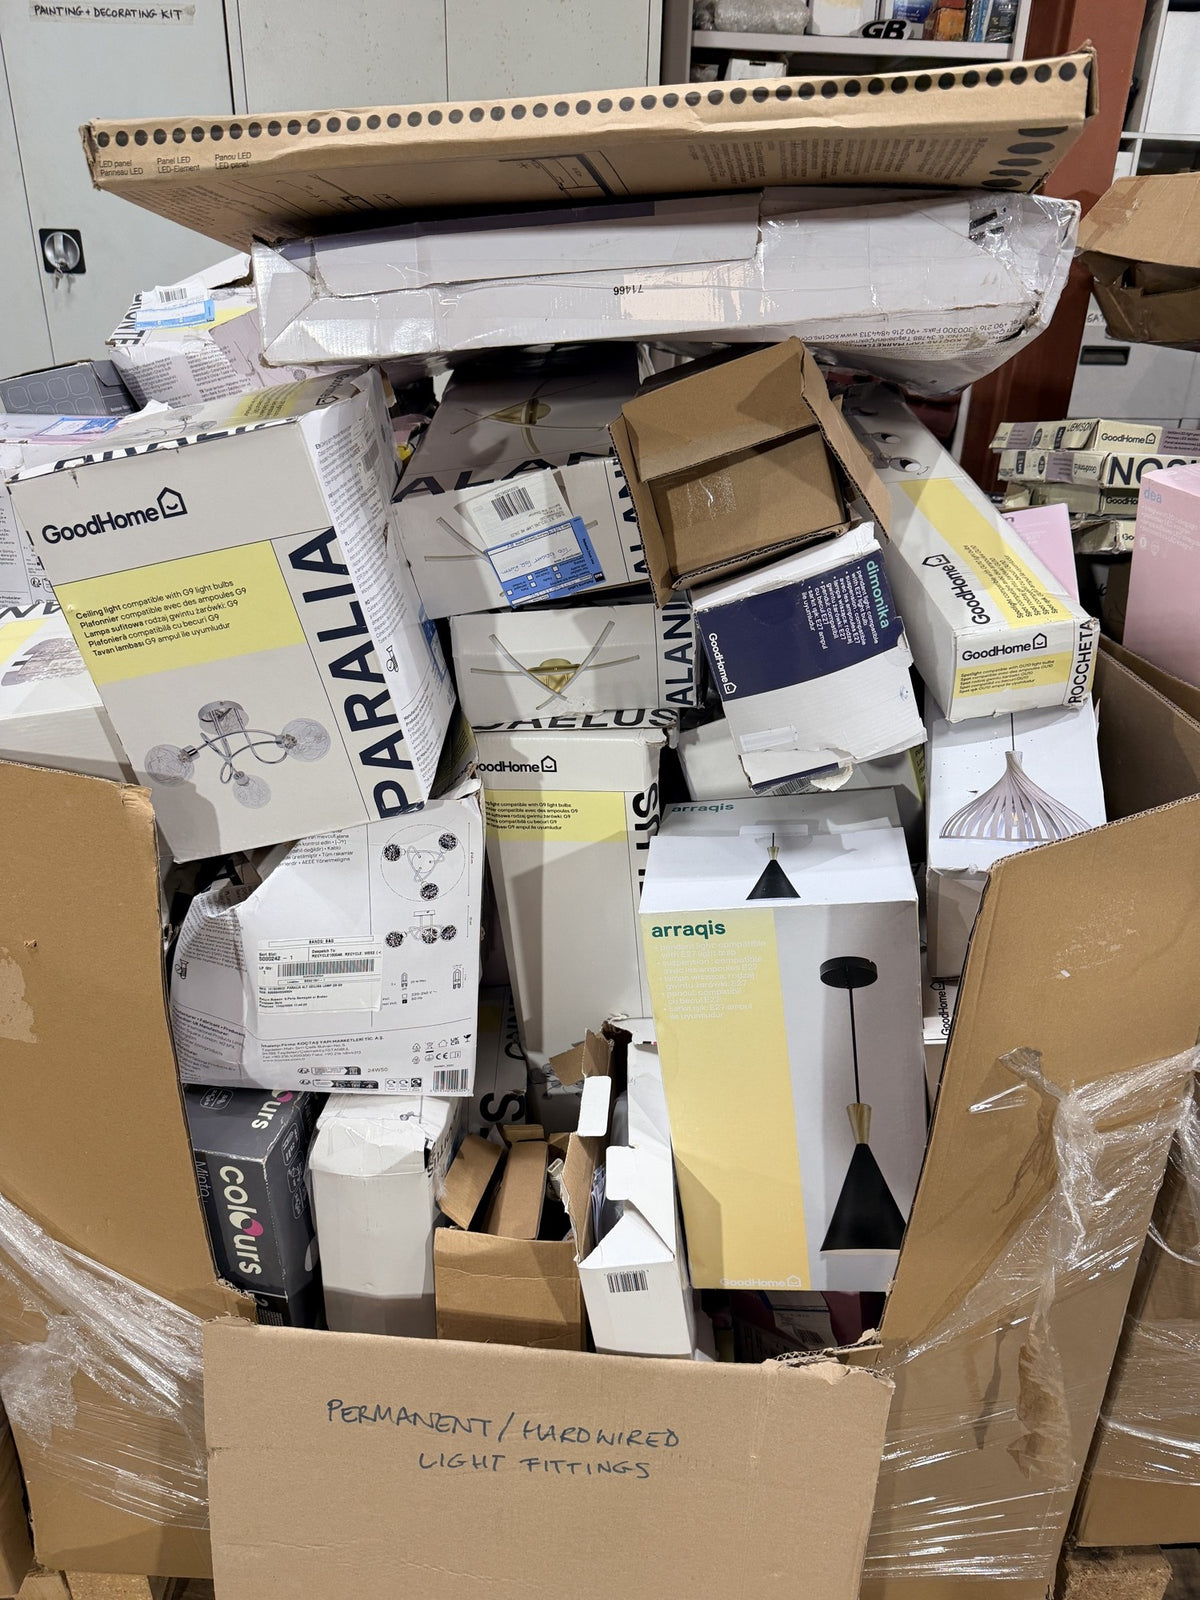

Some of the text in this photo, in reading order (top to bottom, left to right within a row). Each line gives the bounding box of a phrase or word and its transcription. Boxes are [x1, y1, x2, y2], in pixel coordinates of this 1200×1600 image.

[34, 5, 82, 16] PAINTING
[94, 7, 157, 18] DECORATING
[161, 9, 182, 20] KIT
[862, 20, 907, 39] GB
[114, 160, 132, 168] panel
[157, 157, 175, 165] Panel
[215, 161, 249, 170] LED panel
[613, 283, 644, 296] 71466
[1101, 432, 1146, 445] GoodHome
[42, 504, 161, 545] GoodHome
[851, 572, 859, 586] with
[75, 608, 104, 621] Ceiling
[103, 603, 122, 615] light
[122, 594, 165, 611] compatible
[164, 590, 183, 601] with
[182, 587, 195, 597] G9
[194, 583, 213, 596] light
[212, 579, 234, 591] bulbs
[854, 586, 862, 598] E27
[866, 560, 890, 629] dimonika
[940, 563, 991, 625] GoodHome
[80, 587, 247, 629] Plafonnier compatible avec des ampoules G9
[856, 570, 867, 596] pendant
[866, 610, 879, 645] compatible
[84, 627, 111, 640] Lampa
[110, 619, 144, 633] sufitowa
[144, 614, 169, 627] rodzaj
[169, 609, 196, 622] gwintu
[226, 599, 239, 608] G9
[172, 622, 183, 630] cu
[183, 616, 207, 628] becuri
[207, 613, 220, 623] G9
[815, 618, 823, 631] E27
[821, 613, 829, 625] E27
[93, 622, 231, 658] Tavan lambası G9 ampul ile uyumludur
[665, 602, 694, 707] ALANI
[707, 631, 729, 683] GoodHome
[962, 641, 1032, 662] GoodHome
[288, 526, 424, 819] PARALIA
[671, 802, 735, 816] arraqis
[651, 920, 727, 940] arraqis
[937, 990, 951, 1037] GoodHome
[220, 1164, 264, 1276] colours
[719, 1275, 786, 1290] GoodHome
[419, 1452, 651, 1480] LIGHT FITTINGS
